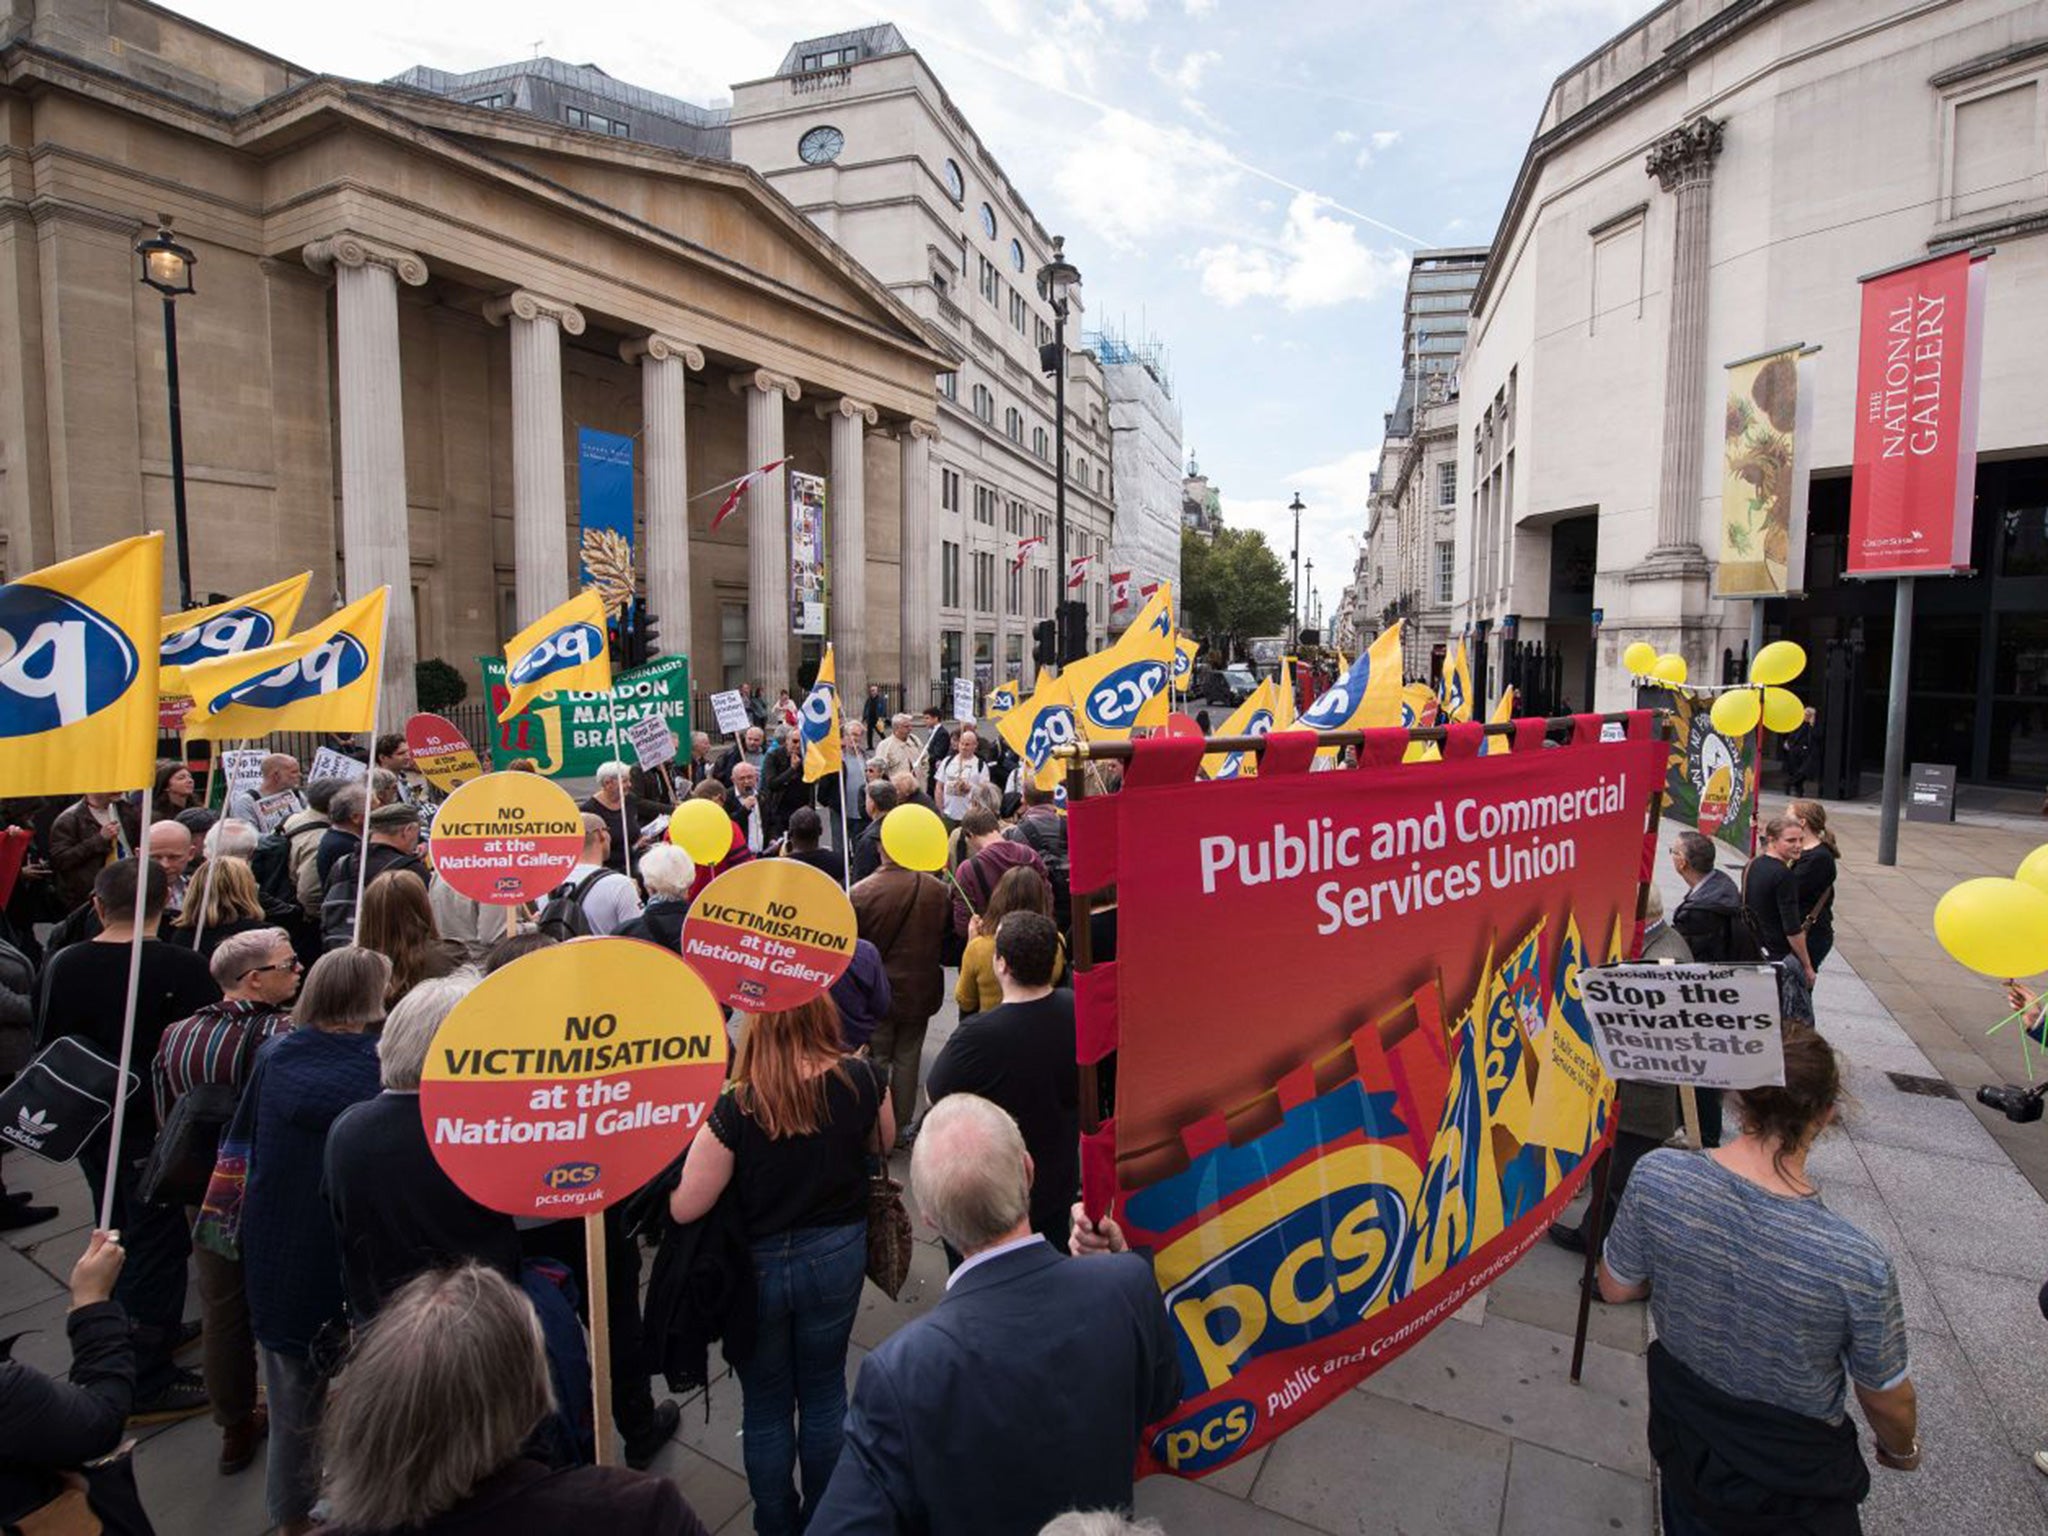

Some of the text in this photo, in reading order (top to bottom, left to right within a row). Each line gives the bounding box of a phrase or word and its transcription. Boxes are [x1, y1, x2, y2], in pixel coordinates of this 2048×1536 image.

[1882, 297, 1915, 460] NATIONAL
[1910, 294, 1946, 456] GALLERY
[1869, 391, 1882, 423] THE
[573, 700, 685, 724] MAGAZINE
[573, 726, 631, 749] BRAN
[498, 807, 525, 820] NO
[441, 821, 577, 836] VICTIMISATION
[1200, 817, 1361, 894] Public
[1370, 800, 1446, 862] and
[1455, 773, 1627, 842] Commercial
[484, 839, 536, 852] at the
[440, 853, 576, 870] National Gallery
[1317, 838, 1576, 935] Services Union
[766, 901, 797, 920] NO
[702, 902, 849, 950] VICTIMISATION
[739, 934, 797, 959] at the
[686, 939, 836, 988] National Gallery
[1586, 980, 1740, 1009] Stop the
[564, 1013, 618, 1041] NO
[1594, 1009, 1773, 1030] privateers
[444, 1035, 712, 1075] VICTIMISATION
[1601, 1027, 1765, 1056] Reinstate
[1609, 1049, 1707, 1077] Candy
[529, 1079, 632, 1110] at the
[3, 1125, 44, 1150] adidas
[435, 1101, 706, 1146] National Gallery
[550, 1166, 597, 1189] pcs
[535, 1189, 604, 1207] pcs.org.uk
[1173, 1199, 1388, 1390] pcs
[1267, 1362, 1322, 1417] Public
[1322, 1346, 1366, 1375] and
[1371, 1284, 1467, 1358] Commercial
[1166, 1405, 1248, 1469] pcs
